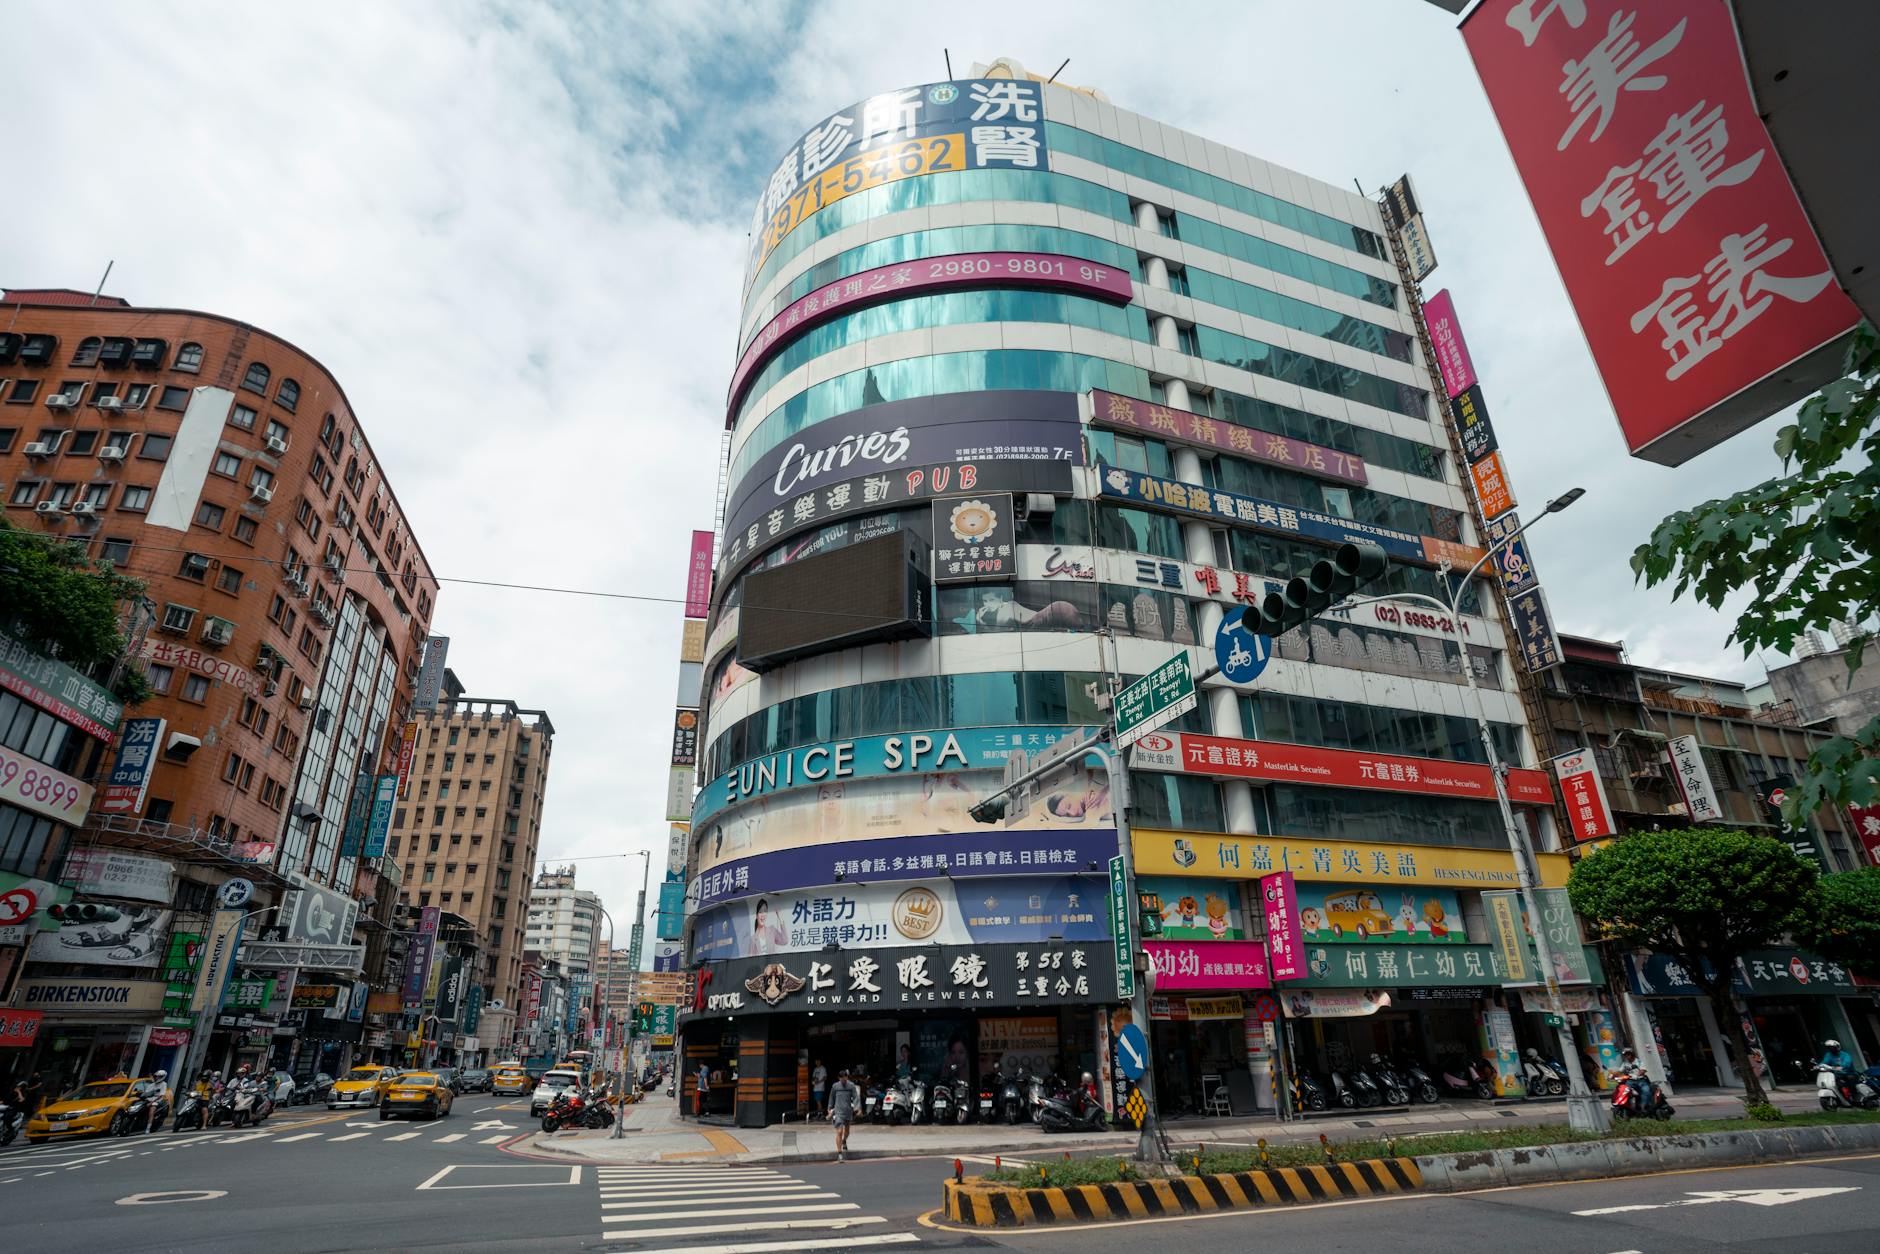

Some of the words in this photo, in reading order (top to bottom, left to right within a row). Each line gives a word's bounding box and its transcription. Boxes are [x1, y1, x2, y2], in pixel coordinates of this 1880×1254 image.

[969, 82, 1041, 167] 洗腎
[929, 258, 1065, 278] 2980-9801
[1080, 265, 1108, 284] 9F
[773, 426, 911, 497] Curves
[906, 464, 978, 497] PUB
[1151, 658, 1184, 690] 正義南路
[1159, 677, 1181, 696] Zhengyi
[1120, 681, 1149, 711] 正義北路
[1125, 700, 1145, 717] Zhengyi
[119, 722, 156, 768] 洗腎
[884, 734, 969, 772] SPA
[1188, 743, 1260, 769] 元富證券
[1263, 761, 1299, 773] MasterLink
[1300, 764, 1331, 776] Securities
[114, 770, 142, 783] 中心
[727, 743, 854, 801] EUNICE
[1358, 759, 1421, 783] 元富證券
[1423, 776, 1454, 788] MasterLink
[1454, 779, 1481, 789] Securities
[1674, 739, 1711, 814] 至善命理
[19, 769, 79, 811] 8899
[1570, 776, 1600, 835] 元富證券
[1114, 859, 1121, 871] 北
[1217, 841, 1417, 878] 何嘉仁菁英美語
[1461, 869, 1503, 882] ENGLISH
[702, 865, 749, 900] 巨匠外語
[791, 896, 856, 925] 外語力
[1141, 895, 1157, 909] 41
[790, 924, 888, 947] 就是競爭力!!
[903, 917, 930, 933] BEST
[1269, 911, 1284, 955] 幼幼
[808, 953, 989, 993] 仁愛眼鏡
[1016, 949, 1088, 973] 第58家
[1155, 948, 1200, 978] 幼幼
[1203, 962, 1265, 977] 產後護理之家
[1751, 960, 1789, 982] 天仁
[1808, 961, 1845, 982] 茗茶
[26, 985, 132, 1003] BIRKENSTOCK
[447, 972, 460, 1004] adidas
[807, 993, 881, 1005] HOWARD
[901, 990, 995, 1002] EYEWEAR
[1016, 975, 1089, 997] 三重分店
